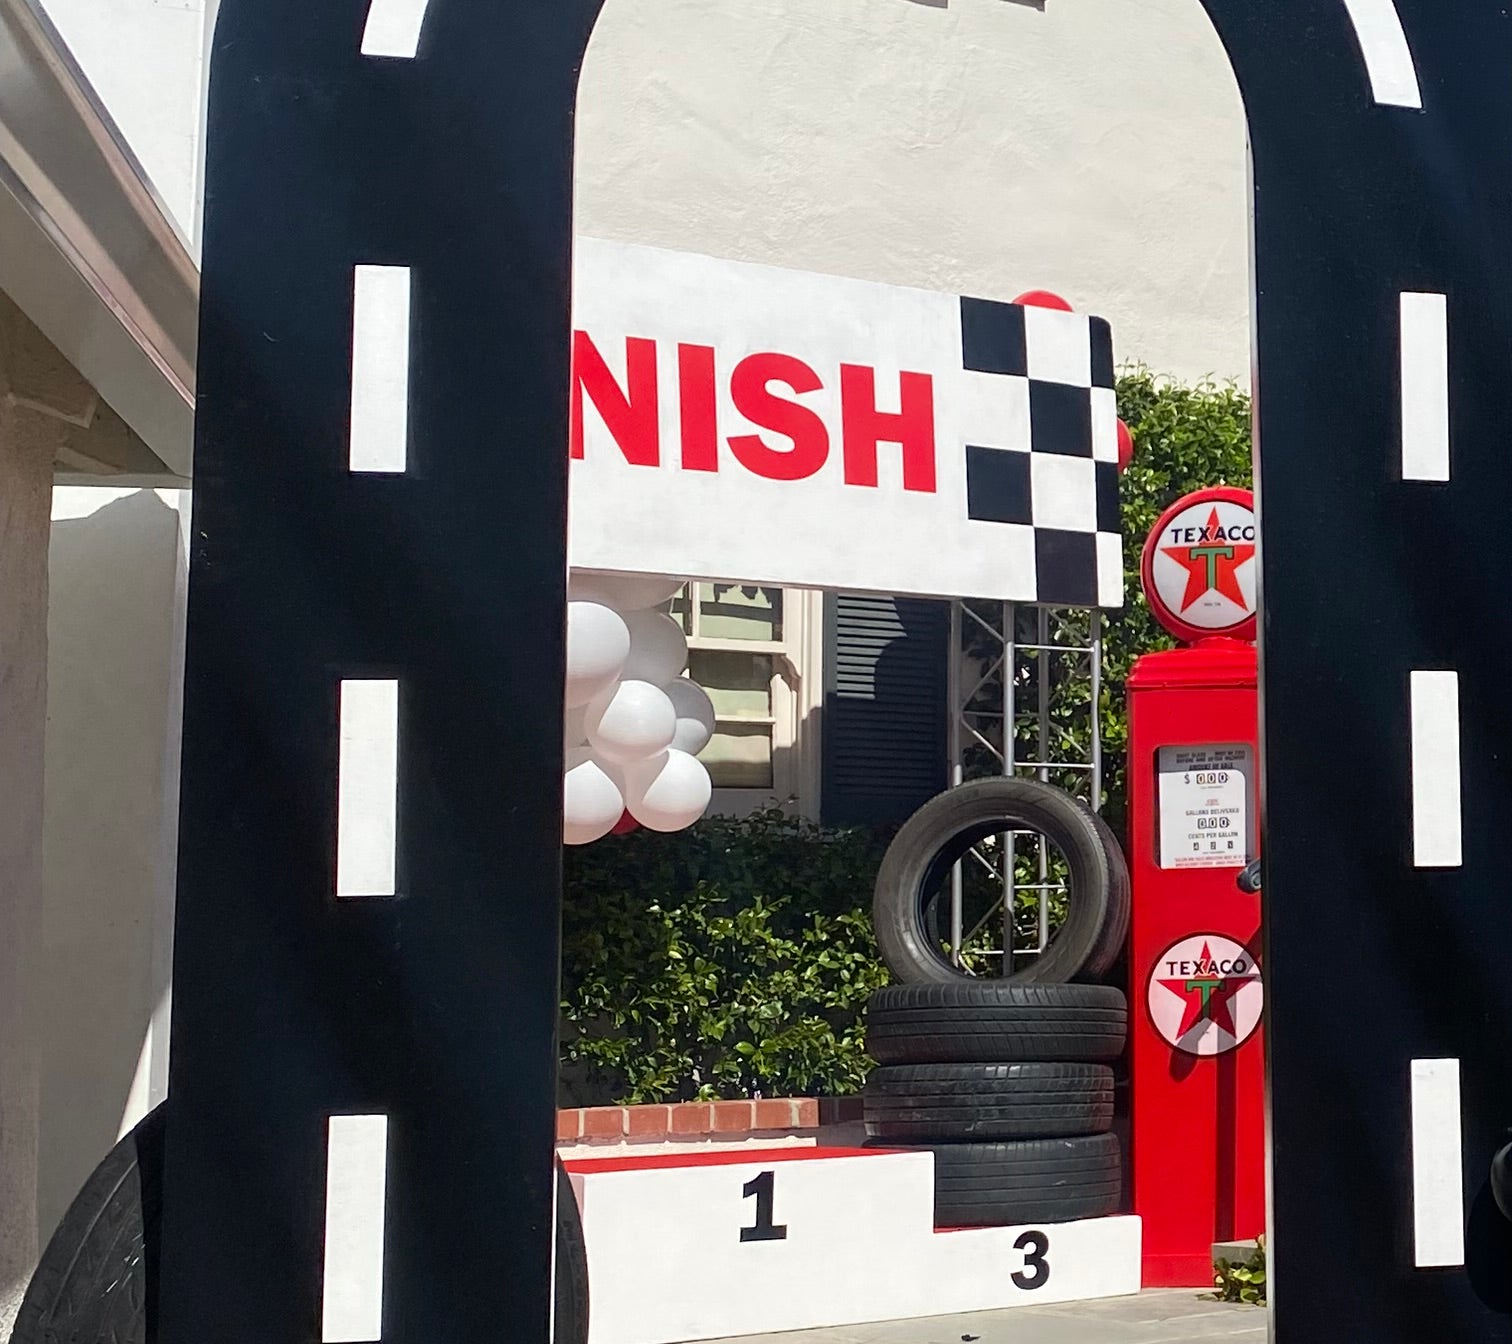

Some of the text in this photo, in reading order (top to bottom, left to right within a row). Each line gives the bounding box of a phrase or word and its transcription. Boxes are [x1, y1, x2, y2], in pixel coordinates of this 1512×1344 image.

[571, 329, 936, 493] NISH
[1171, 526, 1255, 544] TEXACO
[1166, 959, 1247, 976] TEXACO
[739, 1170, 788, 1243] 1
[1010, 1230, 1051, 1291] 3
